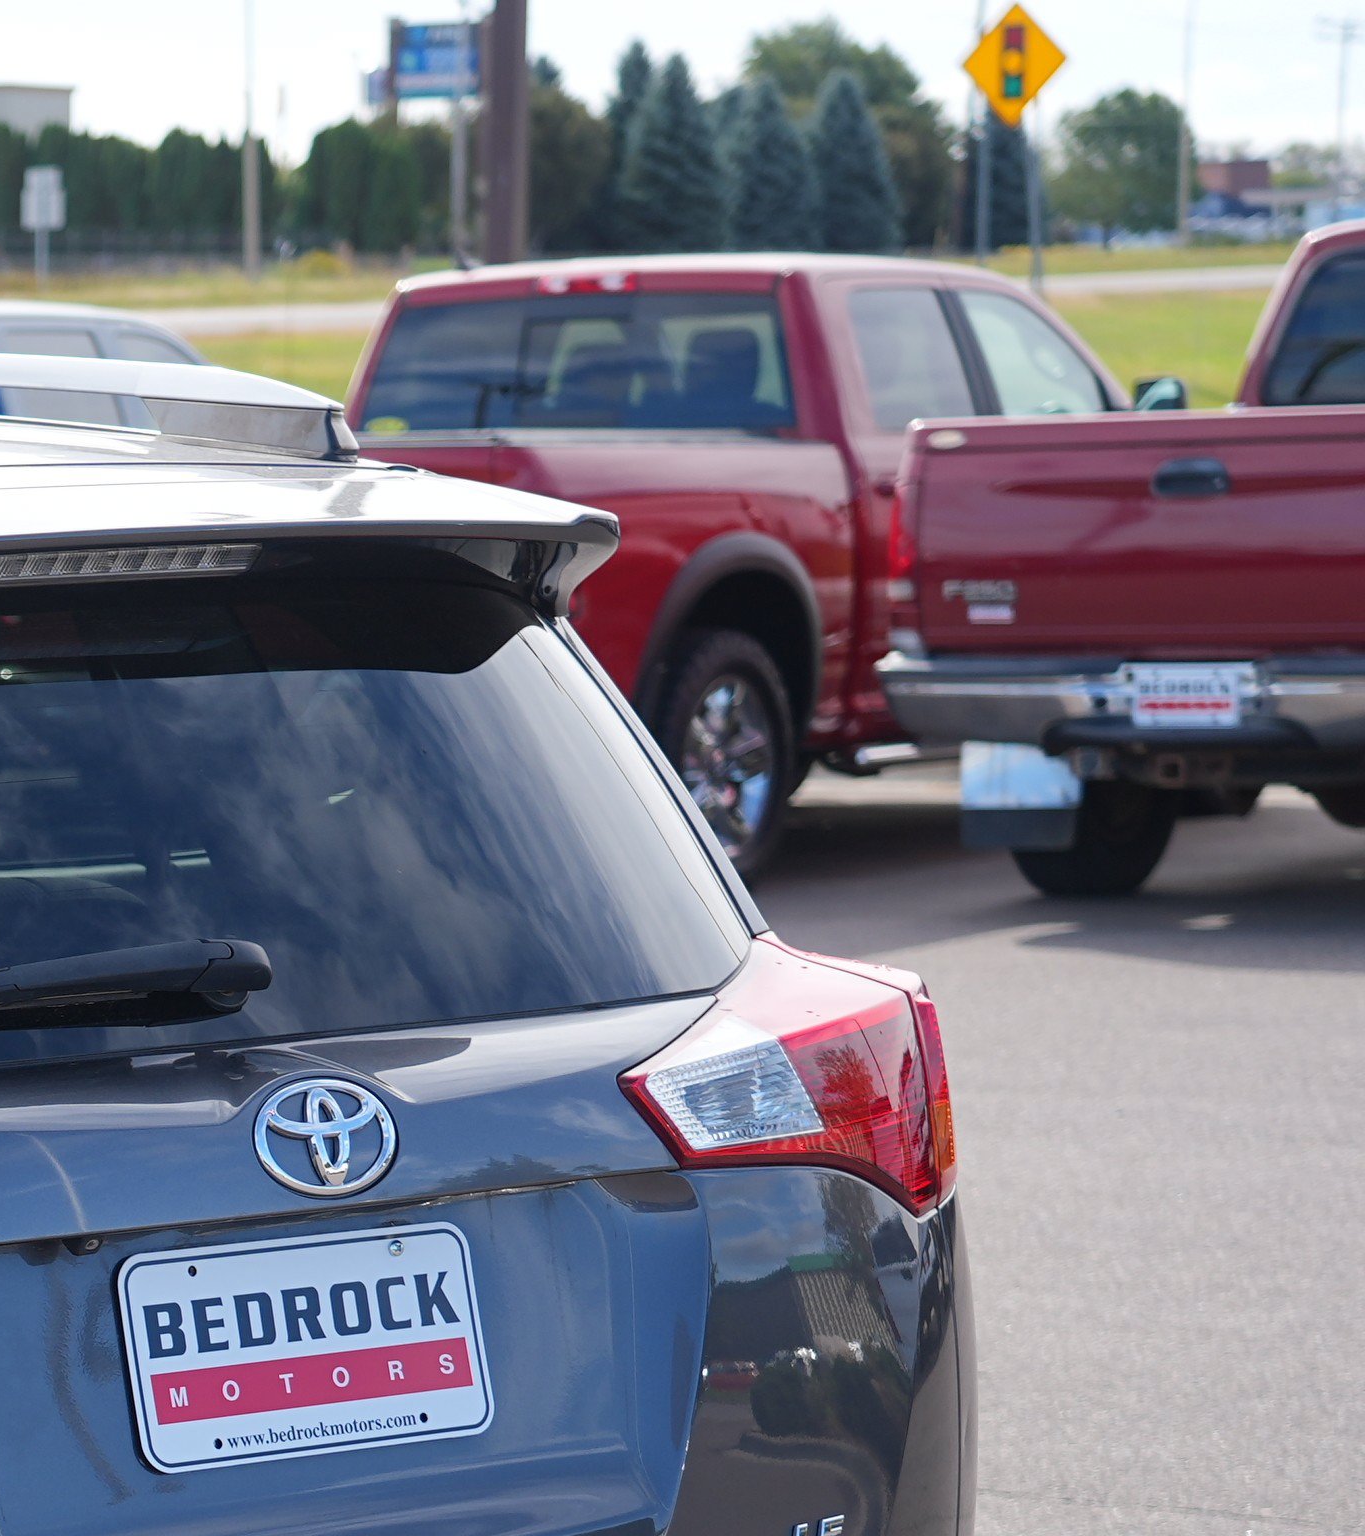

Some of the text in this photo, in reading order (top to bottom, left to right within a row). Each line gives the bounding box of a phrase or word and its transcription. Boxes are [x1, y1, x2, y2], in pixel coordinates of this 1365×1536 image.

[142, 1271, 461, 1359] BEDROCK
[169, 1353, 455, 1408] MOTORS
[227, 1414, 417, 1449] www.bedrockmotors.com
